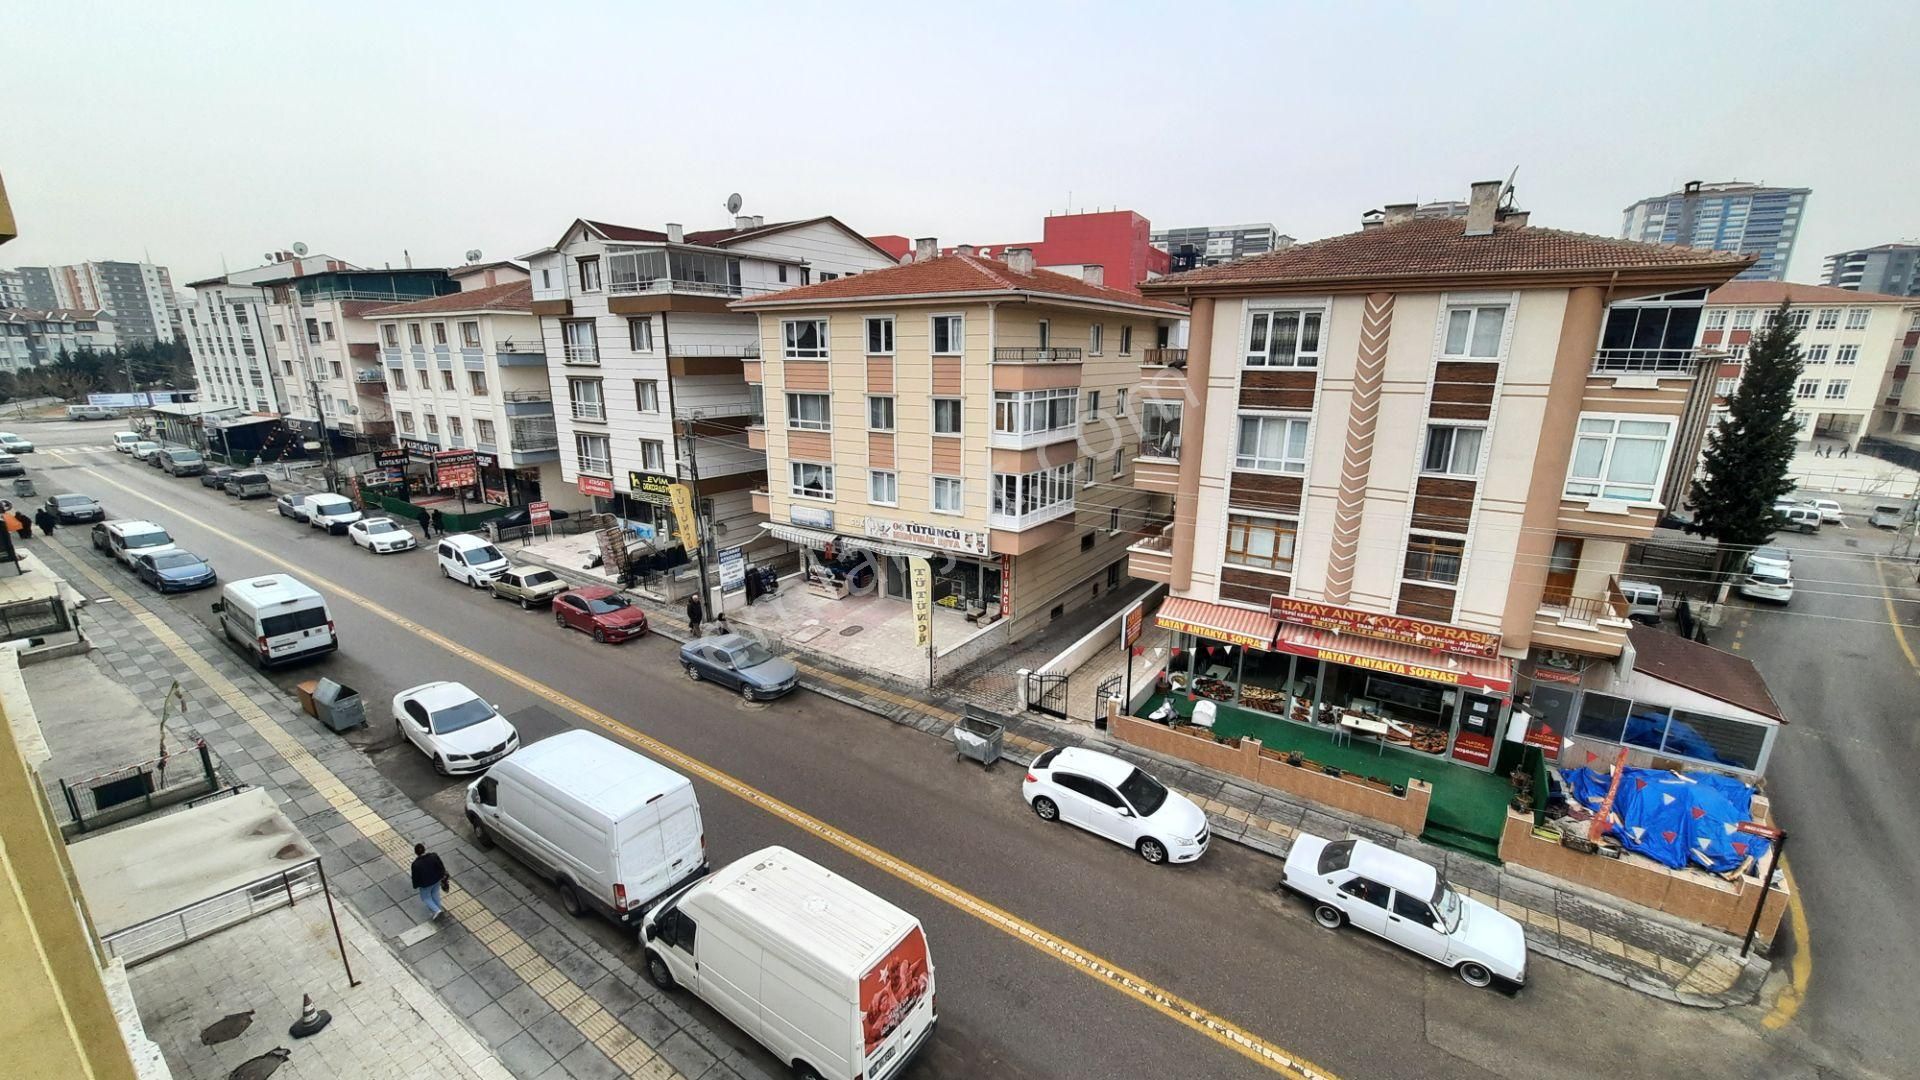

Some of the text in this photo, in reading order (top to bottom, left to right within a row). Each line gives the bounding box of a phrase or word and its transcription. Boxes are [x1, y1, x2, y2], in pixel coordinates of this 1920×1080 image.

[906, 521, 960, 539] TÜTÜNCÜ
[1158, 618, 1185, 631] HATAY
[1186, 624, 1228, 640] ANTAKYA
[1281, 600, 1328, 616] HATAY
[1409, 622, 1487, 643] SOFRASI
[1318, 650, 1458, 683] HATAY ANTAKYA SOFRASI
